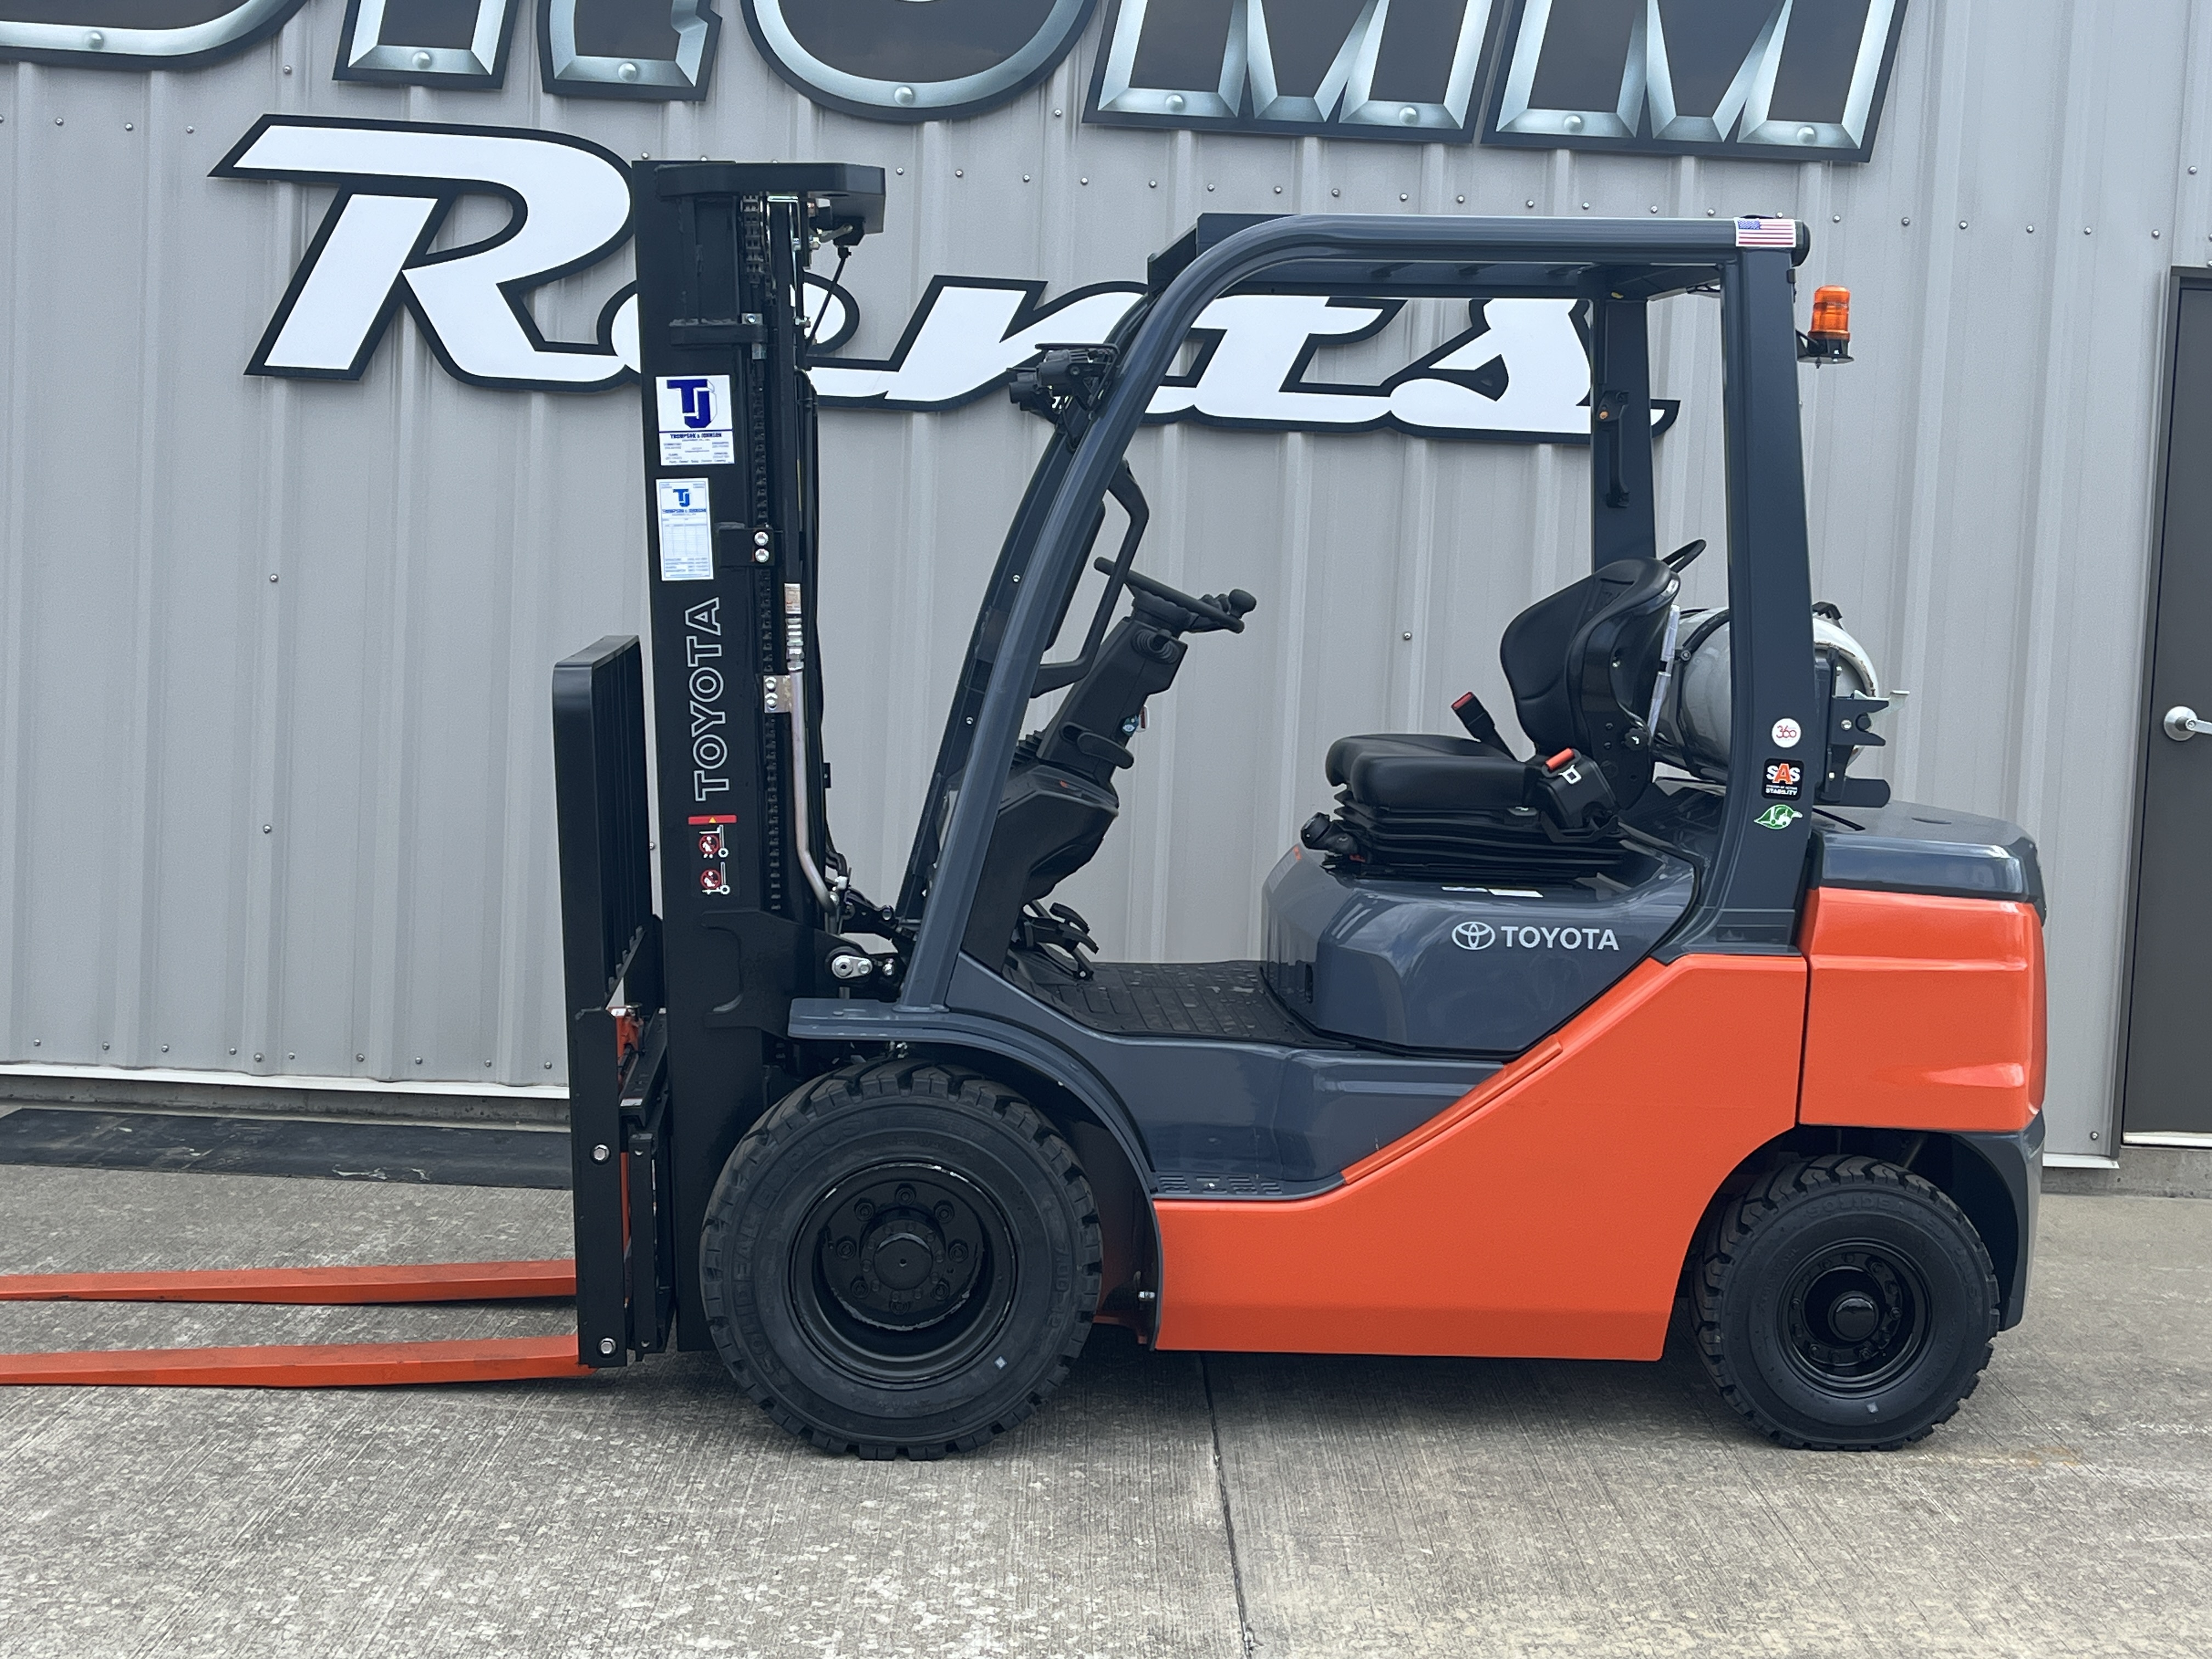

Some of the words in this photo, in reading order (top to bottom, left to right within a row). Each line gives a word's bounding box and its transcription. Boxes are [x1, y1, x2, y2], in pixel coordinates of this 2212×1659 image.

[667, 379, 716, 429] TJ
[684, 596, 730, 802] TOYOTA
[1776, 725, 1797, 738] 360
[1765, 763, 1801, 785] SAS
[1500, 926, 1620, 951] TOYOTA
